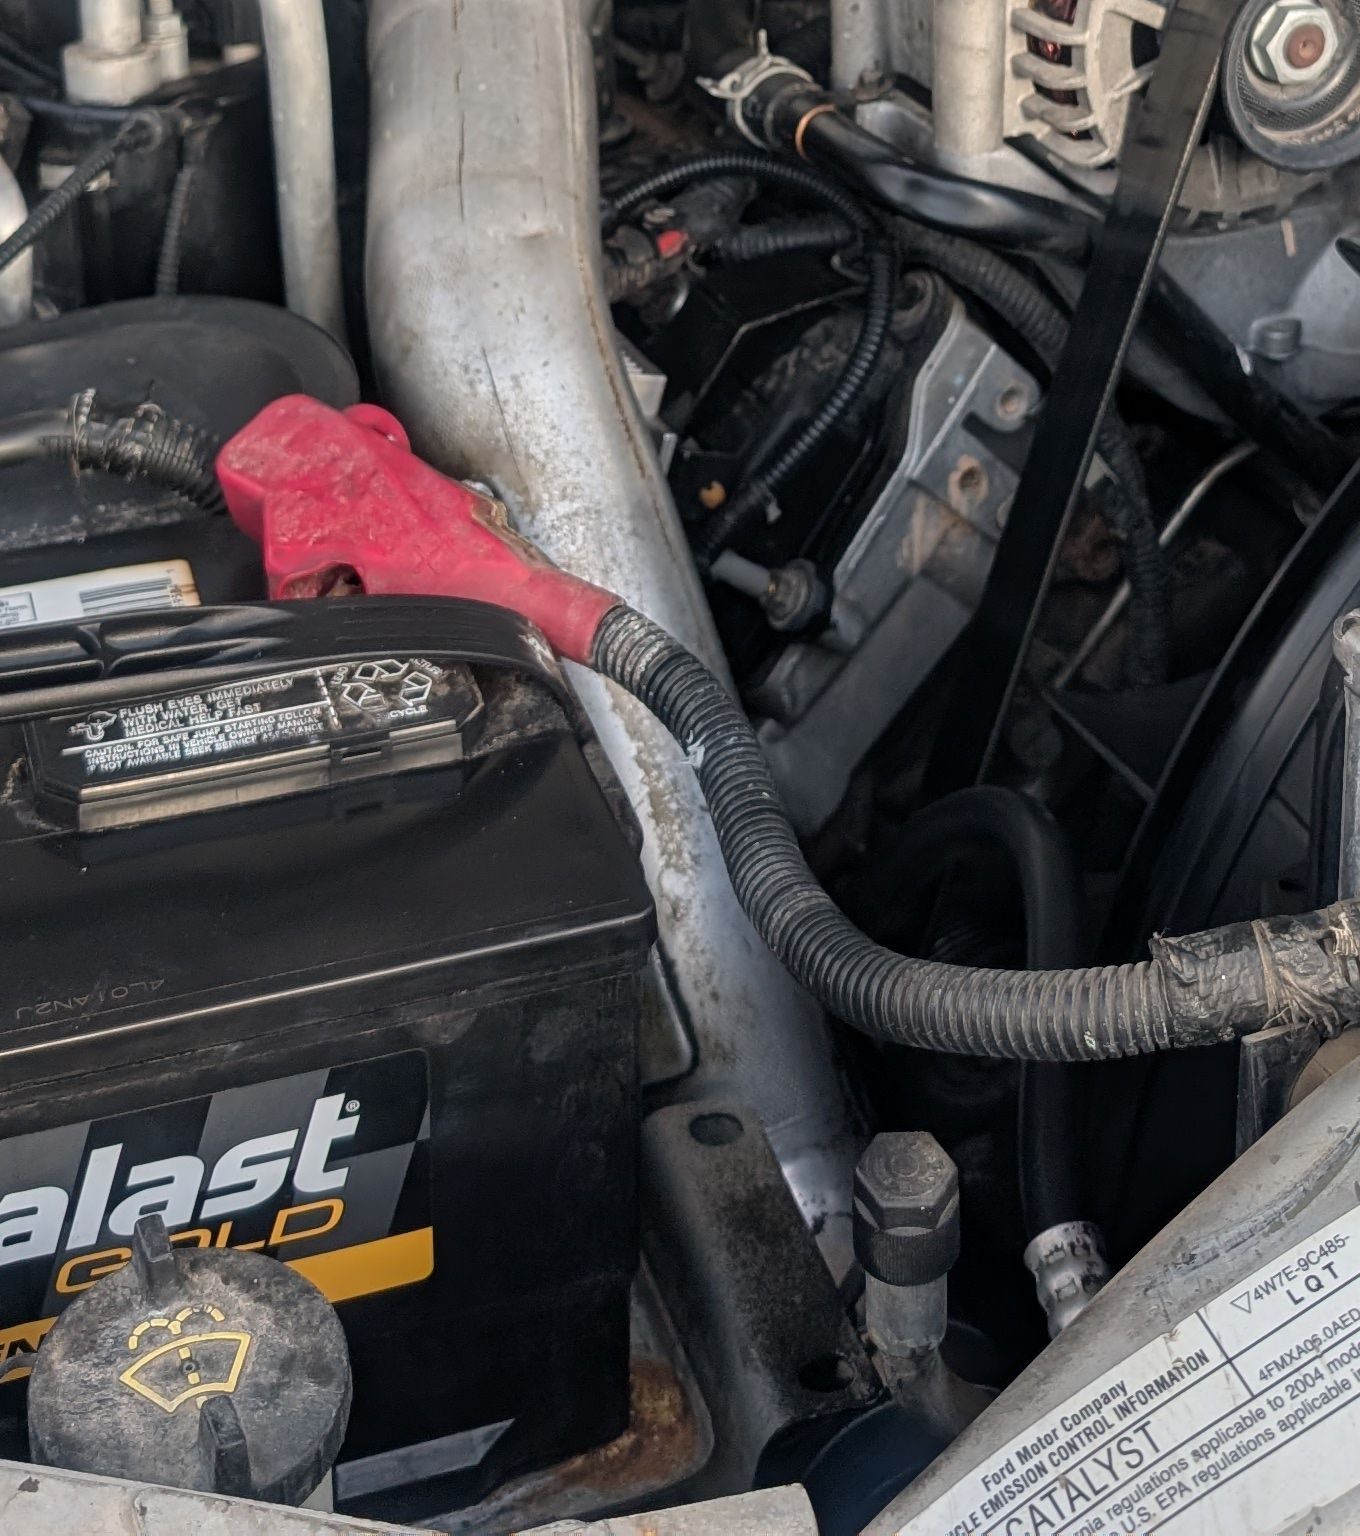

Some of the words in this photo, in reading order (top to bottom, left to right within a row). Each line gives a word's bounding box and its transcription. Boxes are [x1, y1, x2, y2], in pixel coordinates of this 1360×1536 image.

[119, 702, 163, 719] FLUSH
[167, 694, 203, 709] EYES
[206, 677, 295, 702] IMMEDIATELY
[122, 714, 158, 728] WITH
[216, 697, 242, 709] GET
[125, 718, 185, 738] MEDICAL
[189, 711, 223, 726] HELP
[228, 703, 262, 717] FAST
[88, 746, 166, 765] INSTRUCTIONS
[183, 733, 226, 749] VEHICLE
[228, 725, 275, 741] OWNERS
[278, 716, 320, 732] MANUAL
[99, 759, 123, 772] NOT
[185, 743, 213, 756] SEEK
[137, 738, 161, 752] FOR
[163, 732, 189, 746] SAFE
[193, 726, 221, 740] JUMP
[224, 715, 277, 734] STARTING
[279, 706, 323, 722] FOLLOW
[1252, 1233, 1351, 1302] 4W7E-9C485-
[980, 1461, 1050, 1514] EMISSION
[1048, 1418, 1115, 1467] CONTROL
[1116, 1348, 1210, 1422] INFORMATION
[981, 1458, 1017, 1492] Ford
[1015, 1427, 1060, 1465] Motor
[1060, 1380, 1130, 1432] Company
[1105, 1453, 1189, 1522] regulations
[1190, 1406, 1268, 1463] applicable
[1268, 1394, 1286, 1414] to
[1285, 1368, 1326, 1402] 2004
[1122, 1500, 1157, 1534] U.S.
[1154, 1482, 1193, 1511] EPA
[1191, 1428, 1276, 1488] regulations
[1279, 1378, 1353, 1434] applicable
[1004, 1420, 1163, 1536] CATALYST
